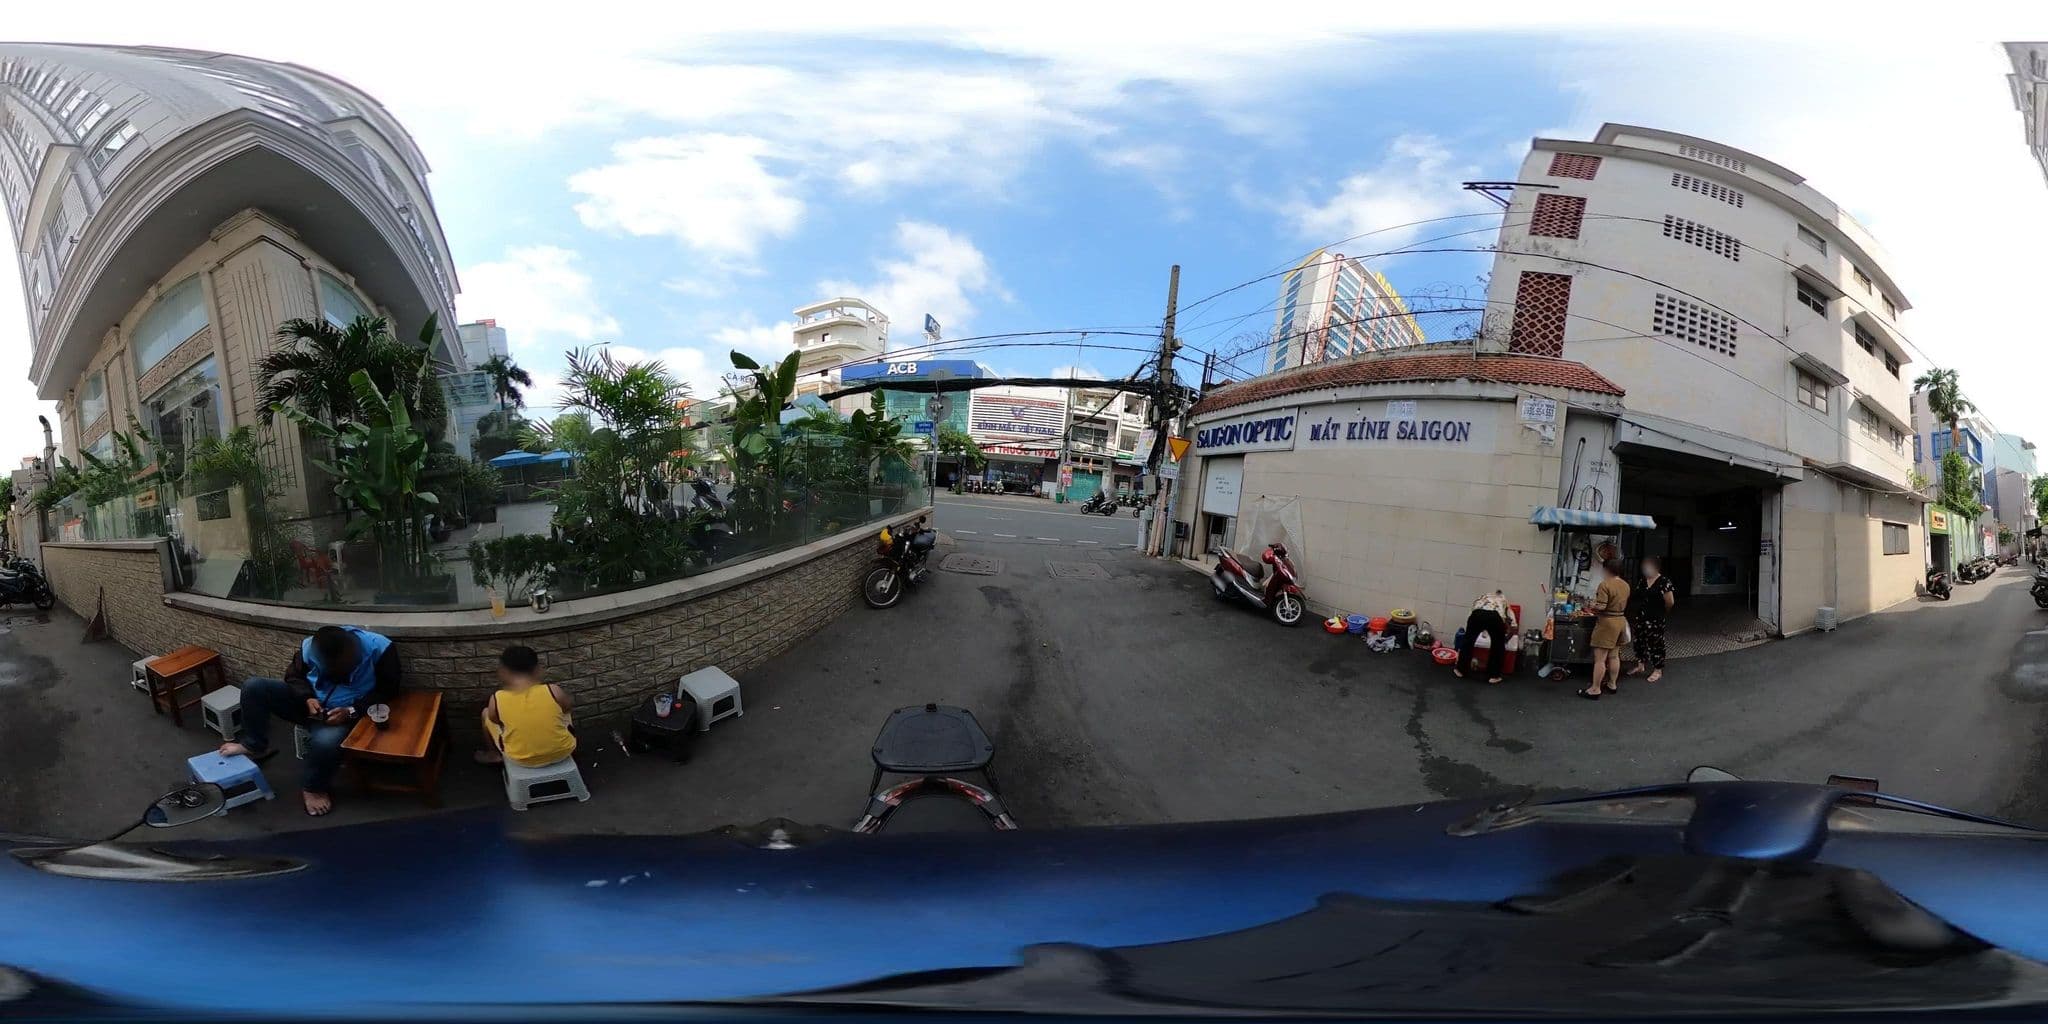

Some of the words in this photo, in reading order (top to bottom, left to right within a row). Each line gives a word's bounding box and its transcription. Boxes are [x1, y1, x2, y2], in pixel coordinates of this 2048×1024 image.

[887, 362, 917, 375] ACB
[1035, 427, 1056, 436] NAM
[1196, 424, 1243, 449] SAIGON
[1242, 415, 1294, 443] OPTIC
[1309, 416, 1341, 441] MẮT
[1346, 416, 1390, 441] KÍNH
[1397, 420, 1471, 442] SAIGON
[999, 443, 1030, 455] THUỐC
[1034, 449, 1057, 458] 199A
